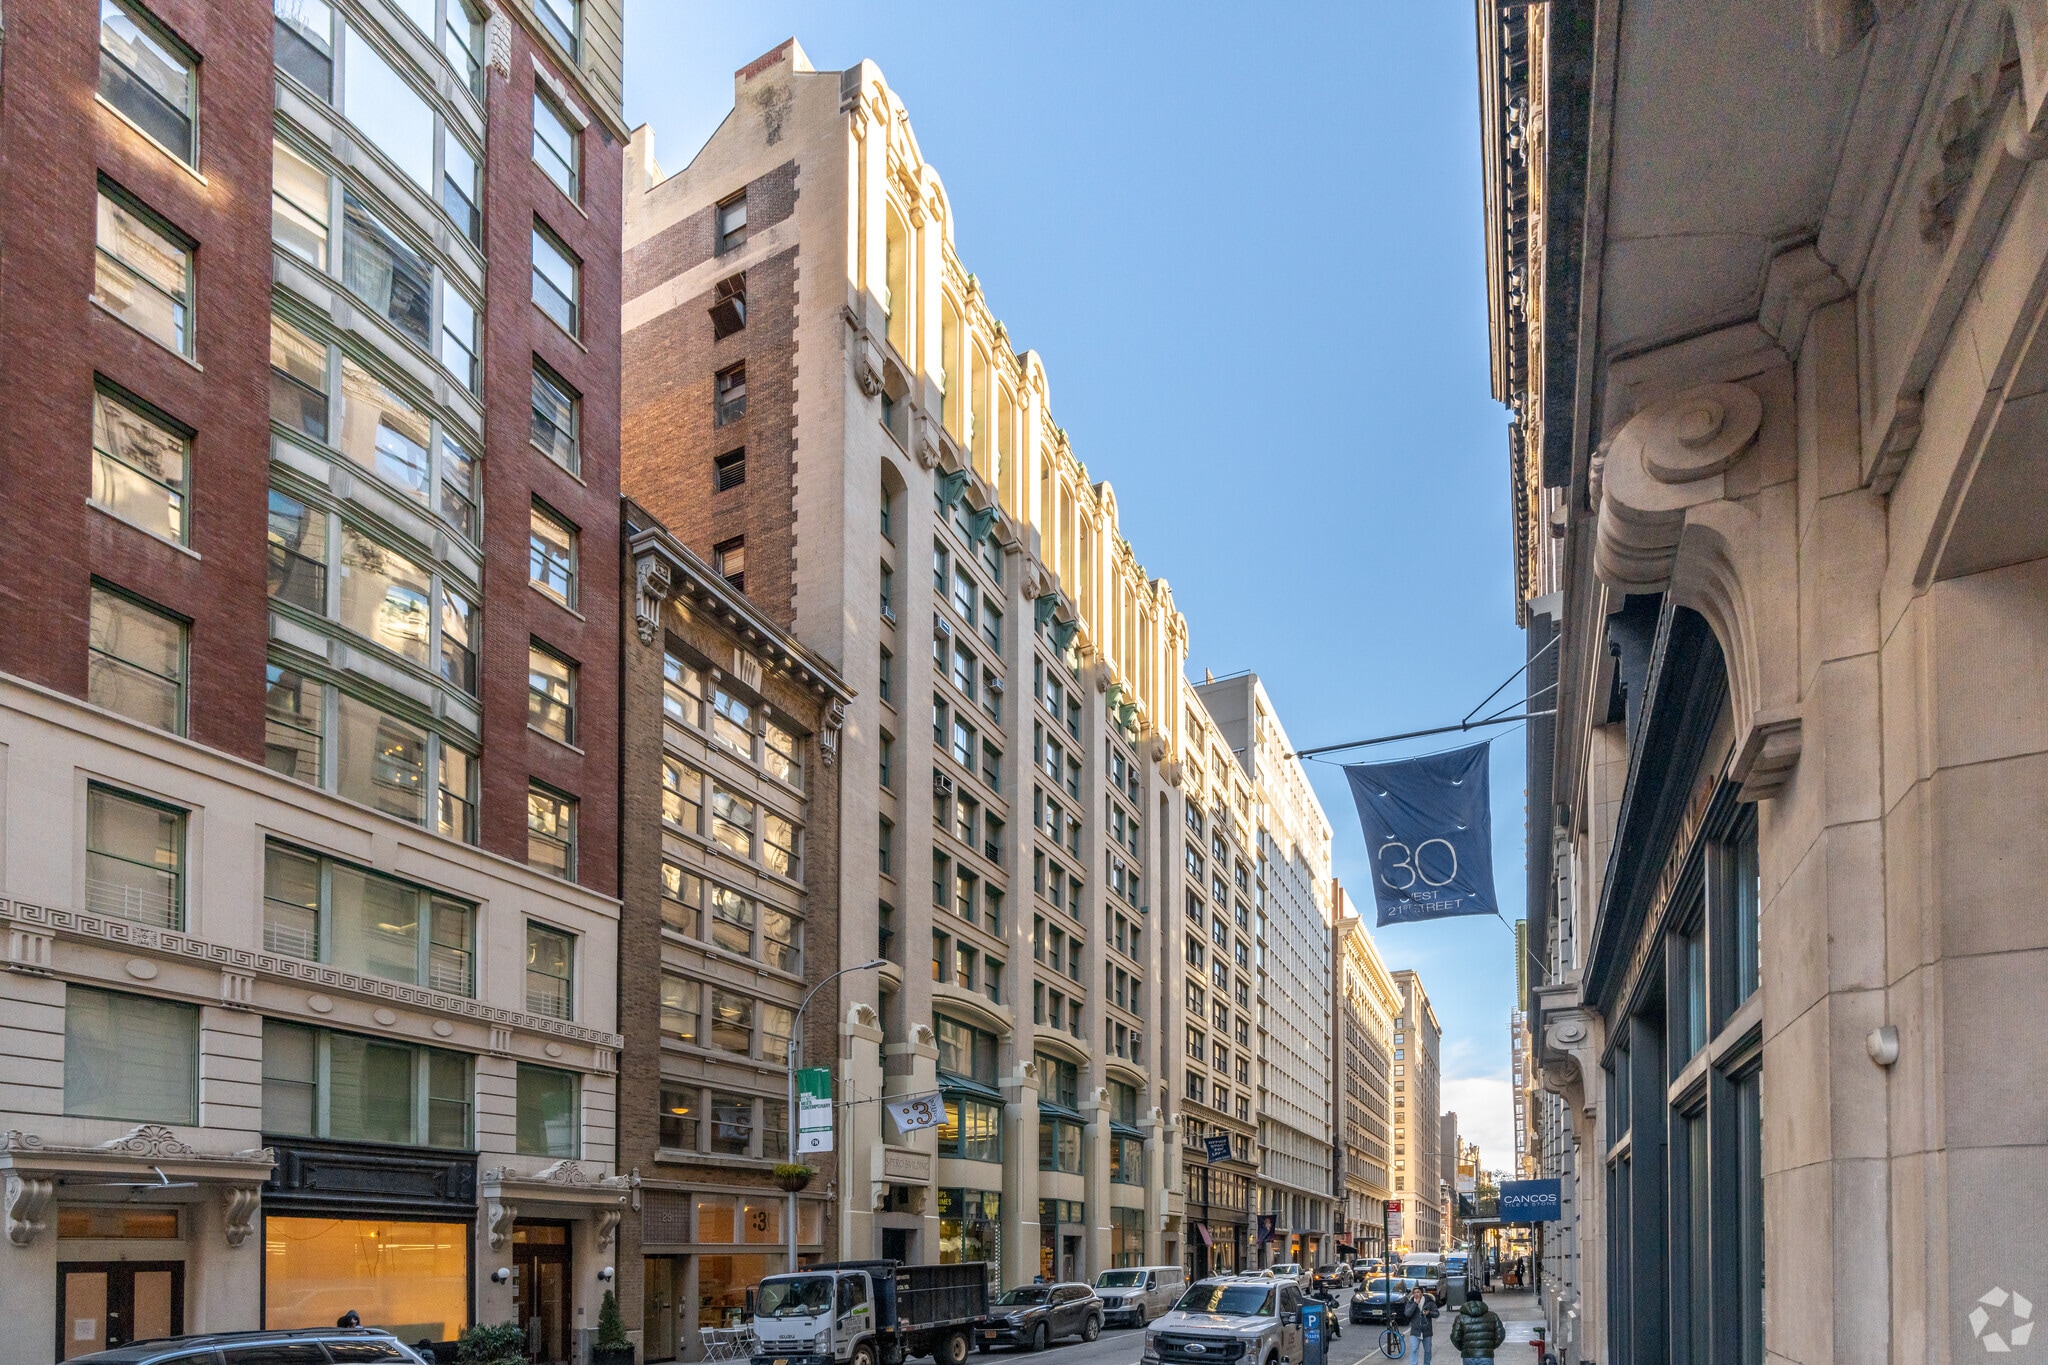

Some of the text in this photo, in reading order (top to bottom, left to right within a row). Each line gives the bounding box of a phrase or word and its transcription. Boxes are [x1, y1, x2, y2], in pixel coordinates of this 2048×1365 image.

[1378, 838, 1457, 890] 30
[1504, 1194, 1557, 1204] CANCOS
[662, 1212, 672, 1222] 29
[1308, 1315, 1316, 1327] P
